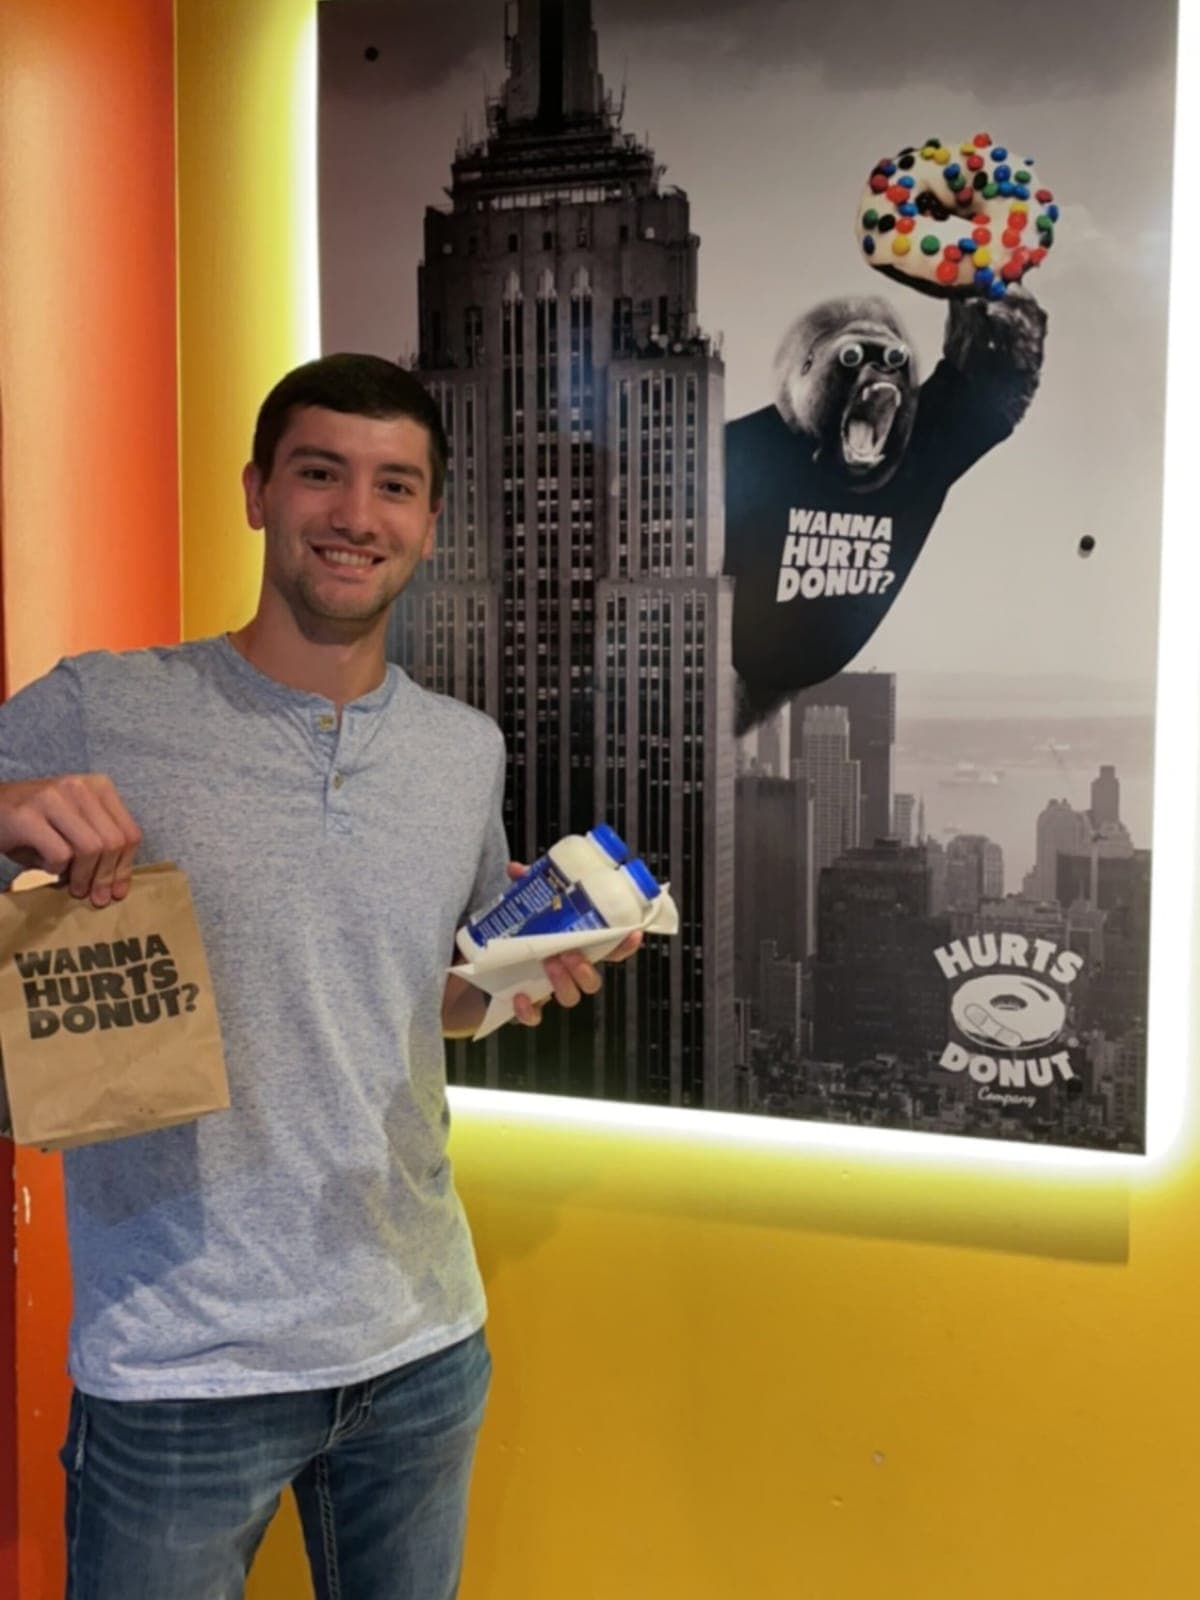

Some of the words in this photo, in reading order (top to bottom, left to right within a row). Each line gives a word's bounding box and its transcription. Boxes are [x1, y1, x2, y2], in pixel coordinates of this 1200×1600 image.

[789, 508, 892, 541] WANNA
[782, 535, 891, 569] HURTS
[776, 567, 895, 602] DONUT?
[14, 934, 169, 979] WANNA
[934, 933, 1084, 984] HURTS
[23, 959, 178, 1008] HURTS
[28, 983, 199, 1040] DONUT?
[939, 1042, 1074, 1088] DONUT
[978, 1086, 1036, 1107] Company
